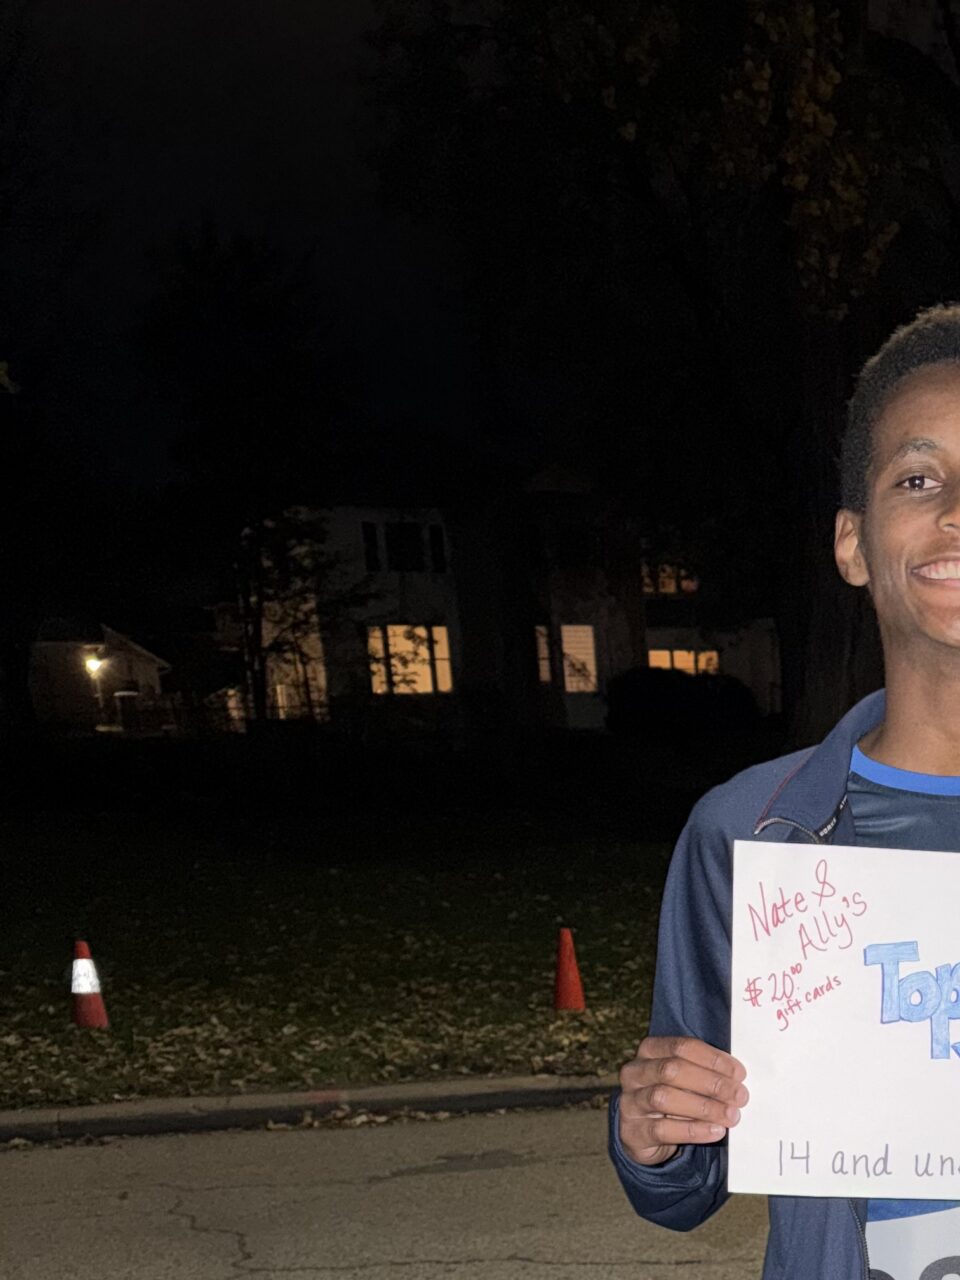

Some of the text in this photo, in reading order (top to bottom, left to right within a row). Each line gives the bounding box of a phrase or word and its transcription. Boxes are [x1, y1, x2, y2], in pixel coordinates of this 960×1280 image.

[747, 858, 836, 941] Nate &
[798, 891, 868, 961] Ally's
[776, 975, 842, 1032] gift cards
[778, 1139, 811, 1177] 14
[831, 1143, 893, 1179] and
